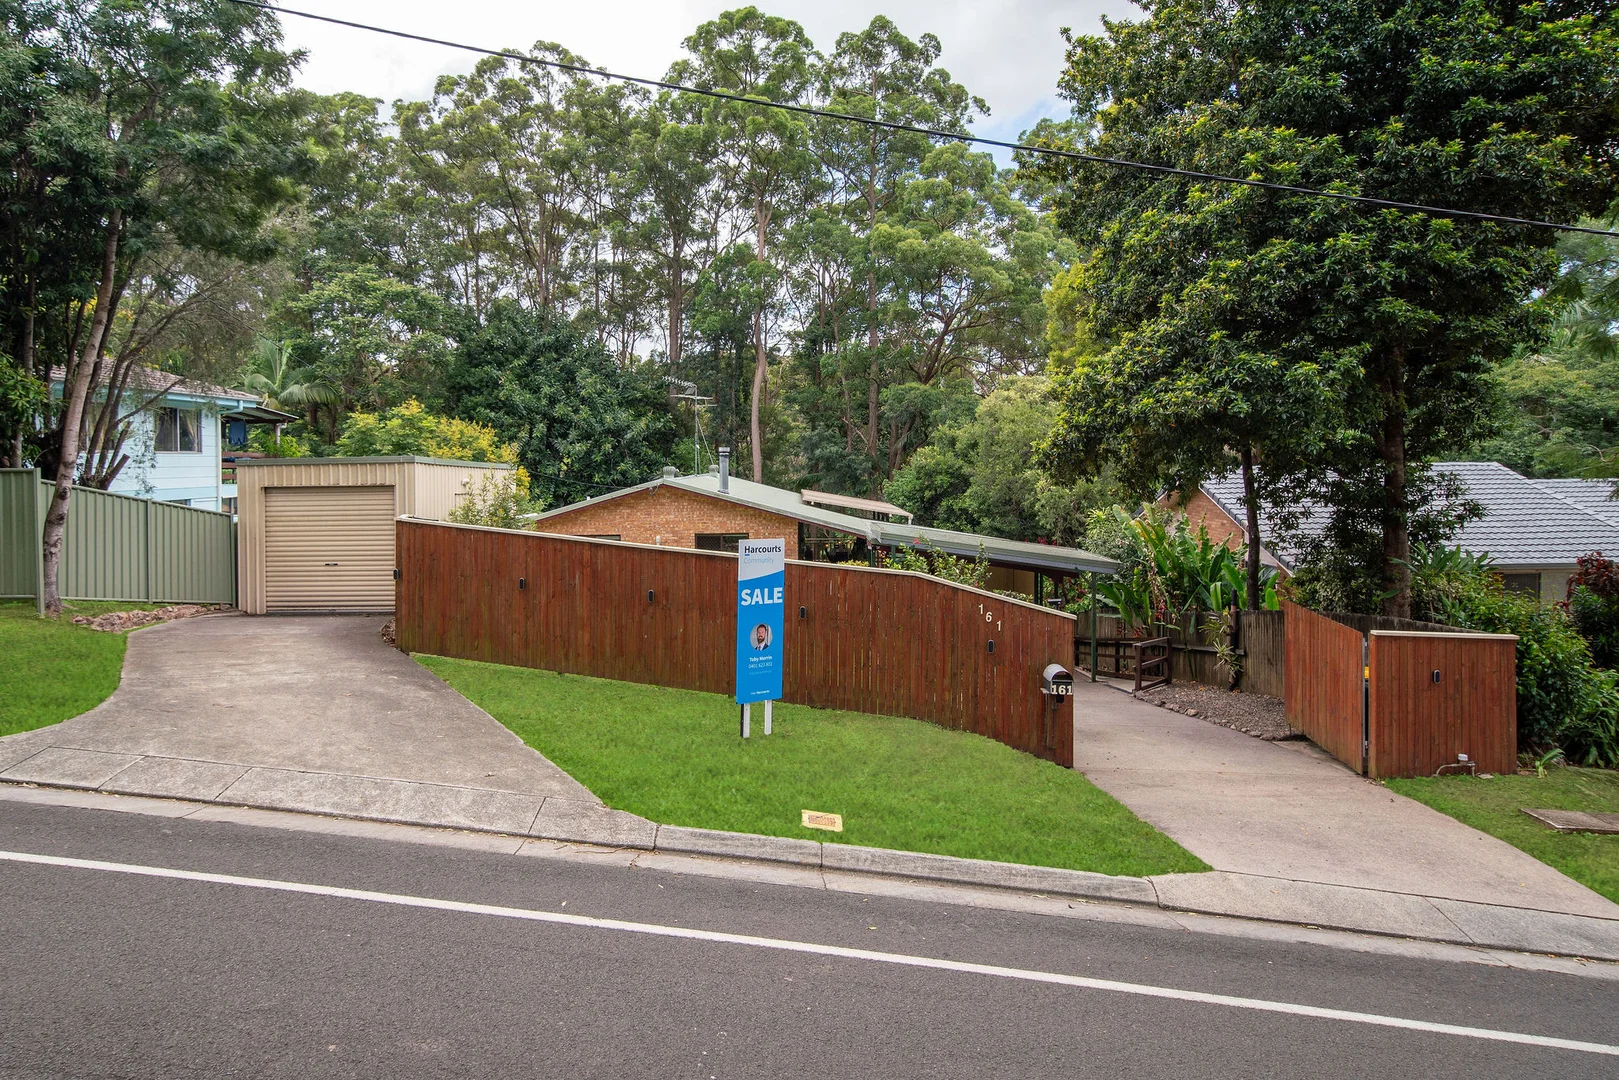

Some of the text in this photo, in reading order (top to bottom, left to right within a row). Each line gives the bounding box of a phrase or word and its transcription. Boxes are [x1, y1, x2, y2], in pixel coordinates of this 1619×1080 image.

[744, 545, 782, 554] Harcourts
[741, 587, 783, 606] SALE
[978, 603, 1002, 632] 161
[1051, 684, 1073, 695] 161
